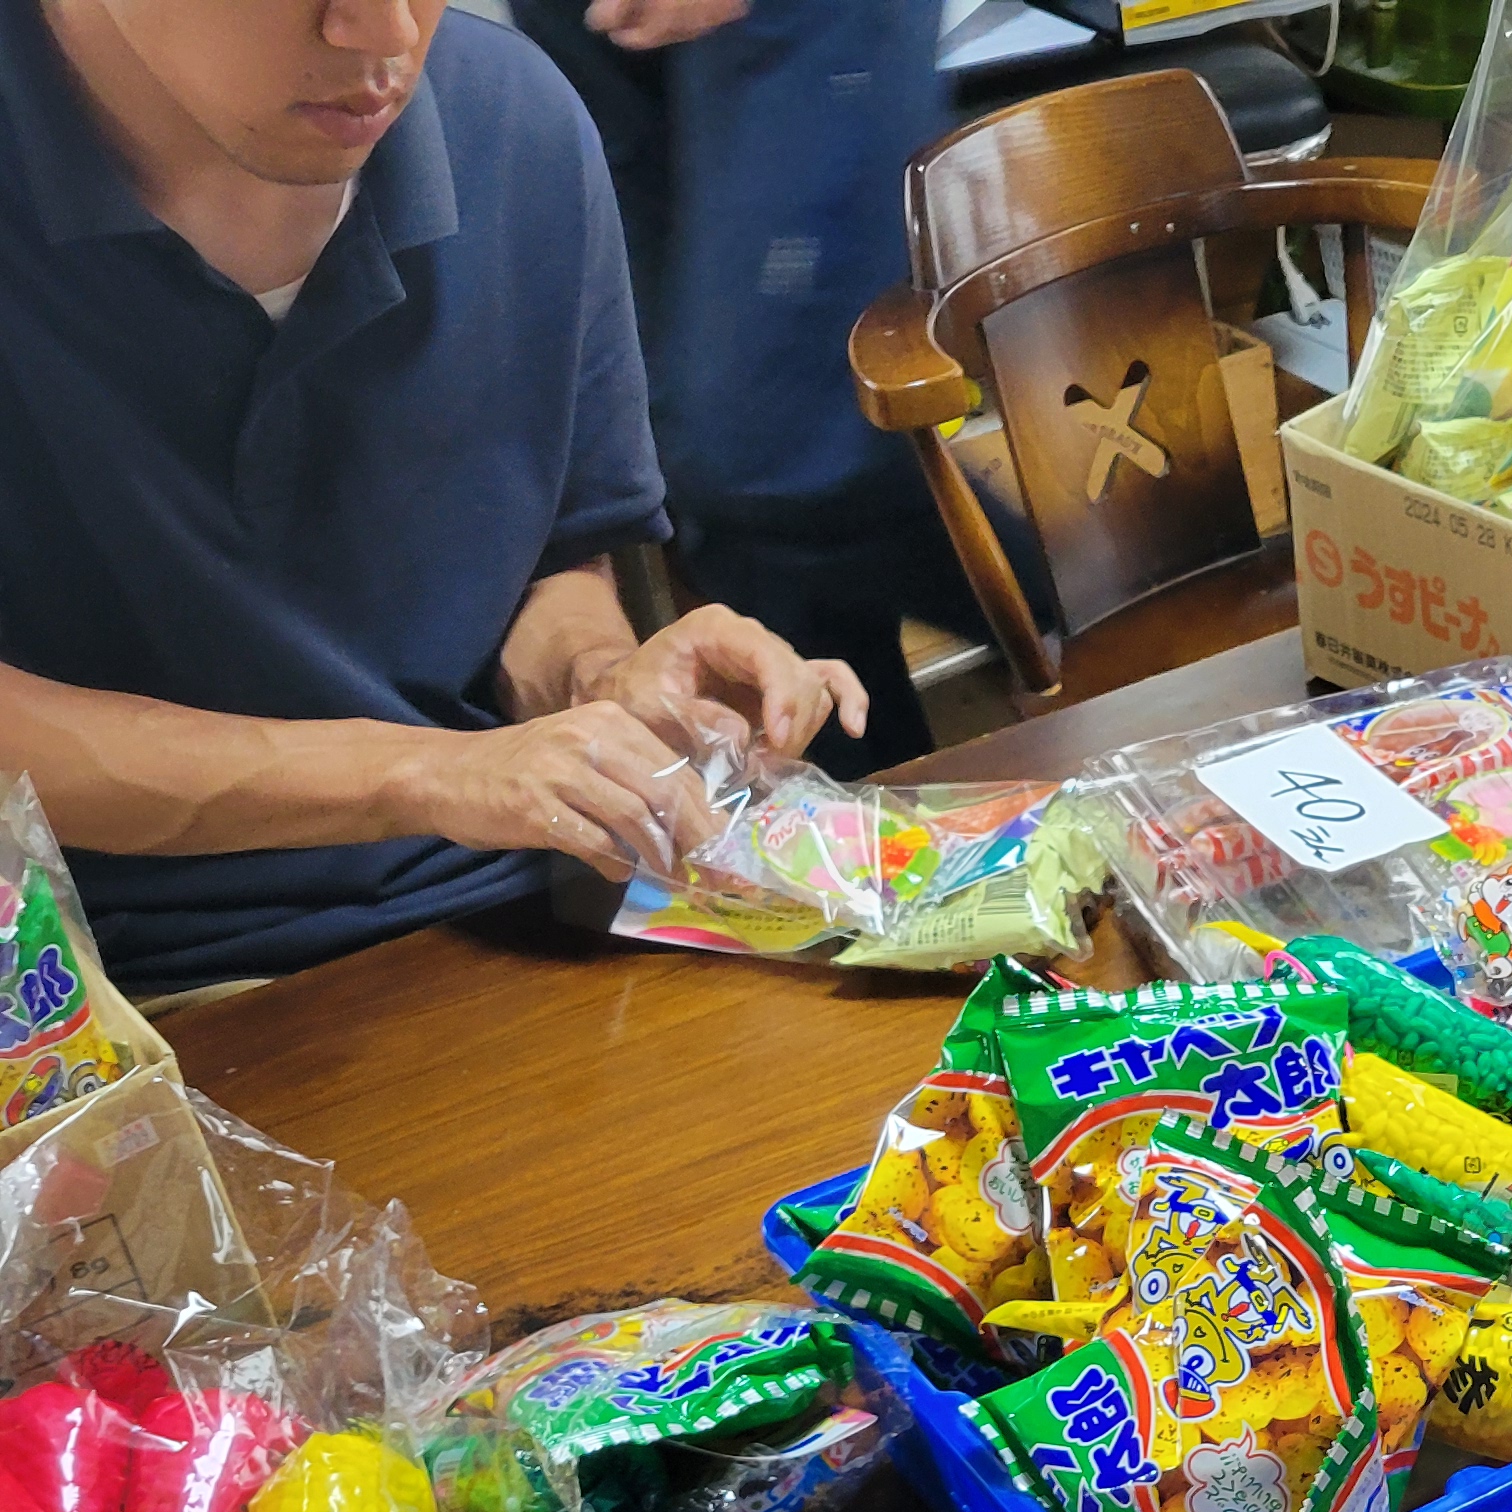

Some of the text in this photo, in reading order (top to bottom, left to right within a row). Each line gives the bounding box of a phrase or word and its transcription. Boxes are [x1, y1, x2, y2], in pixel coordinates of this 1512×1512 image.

[1047, 1003, 1288, 1100] キャベツ
[1203, 1039, 1341, 1128] 太郎
[1048, 1365, 1160, 1506] 太郎
